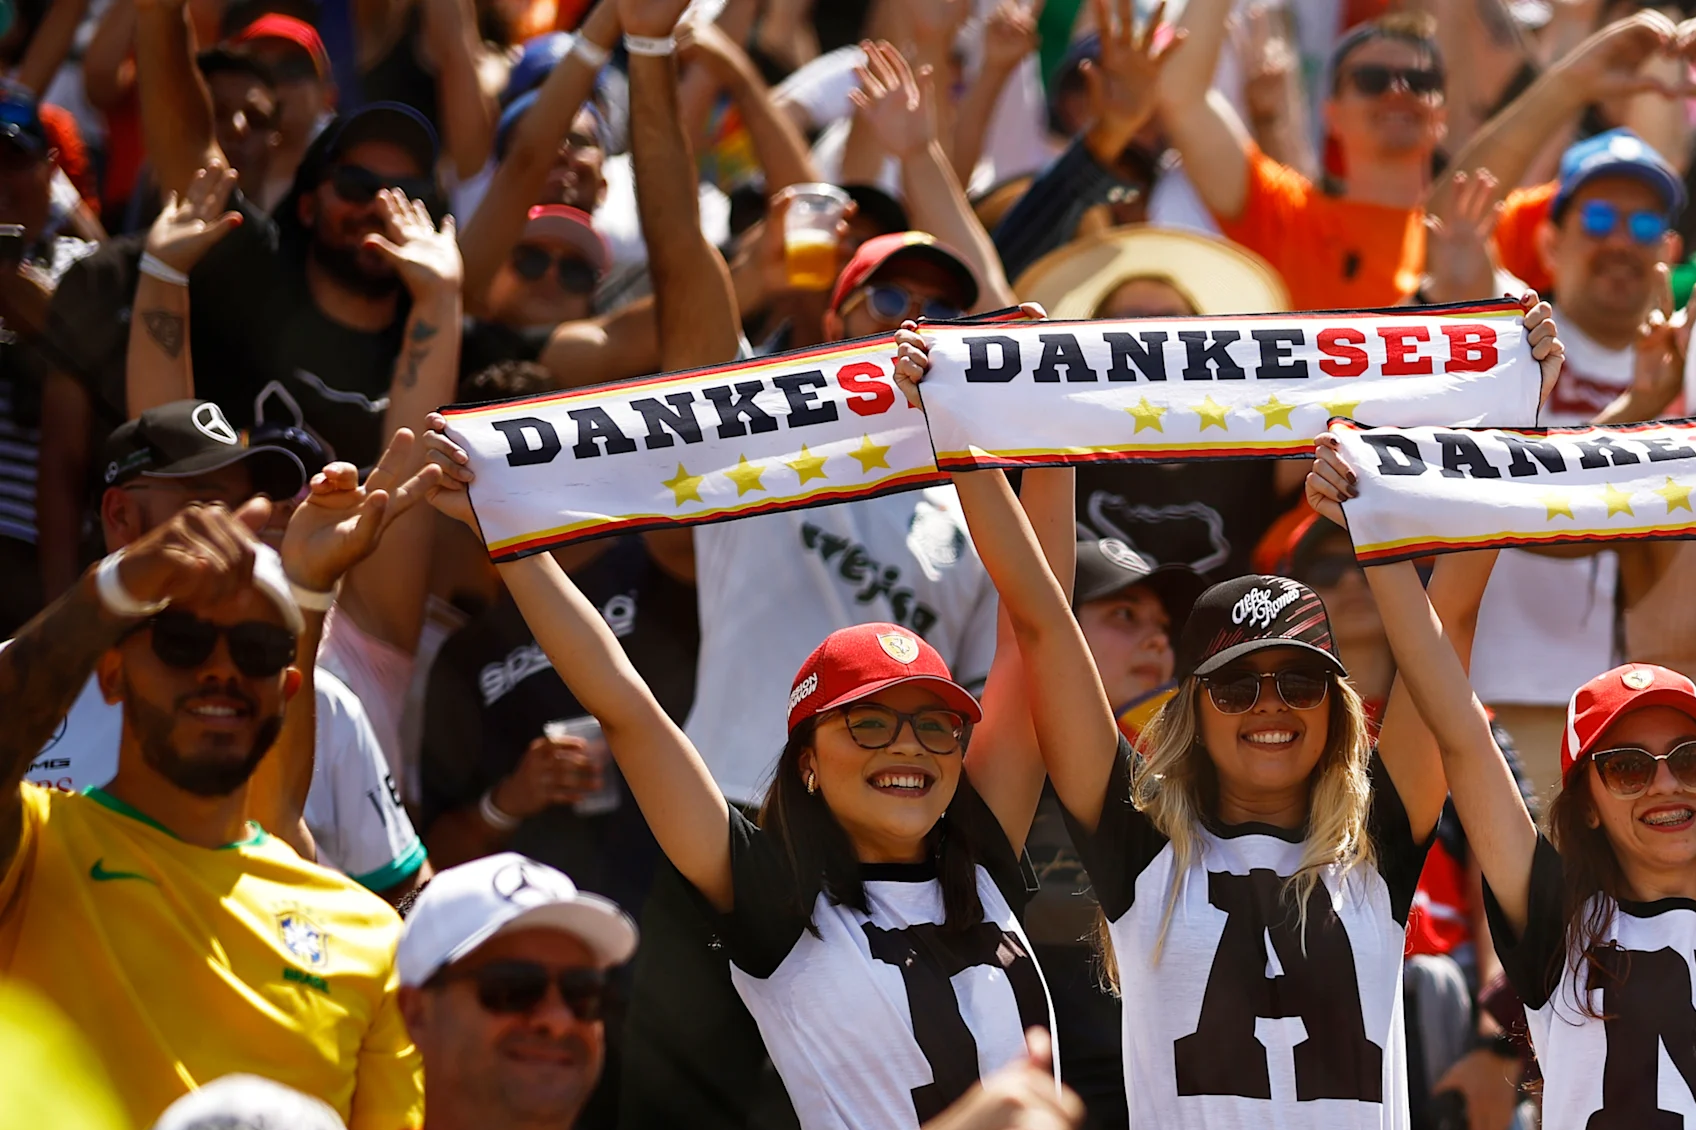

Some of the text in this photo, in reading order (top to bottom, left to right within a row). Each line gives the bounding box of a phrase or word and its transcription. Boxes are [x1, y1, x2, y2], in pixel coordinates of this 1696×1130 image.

[963, 324, 1498, 383] DANKESEB
[491, 357, 922, 467] DANKES
[1174, 869, 1383, 1103] A
